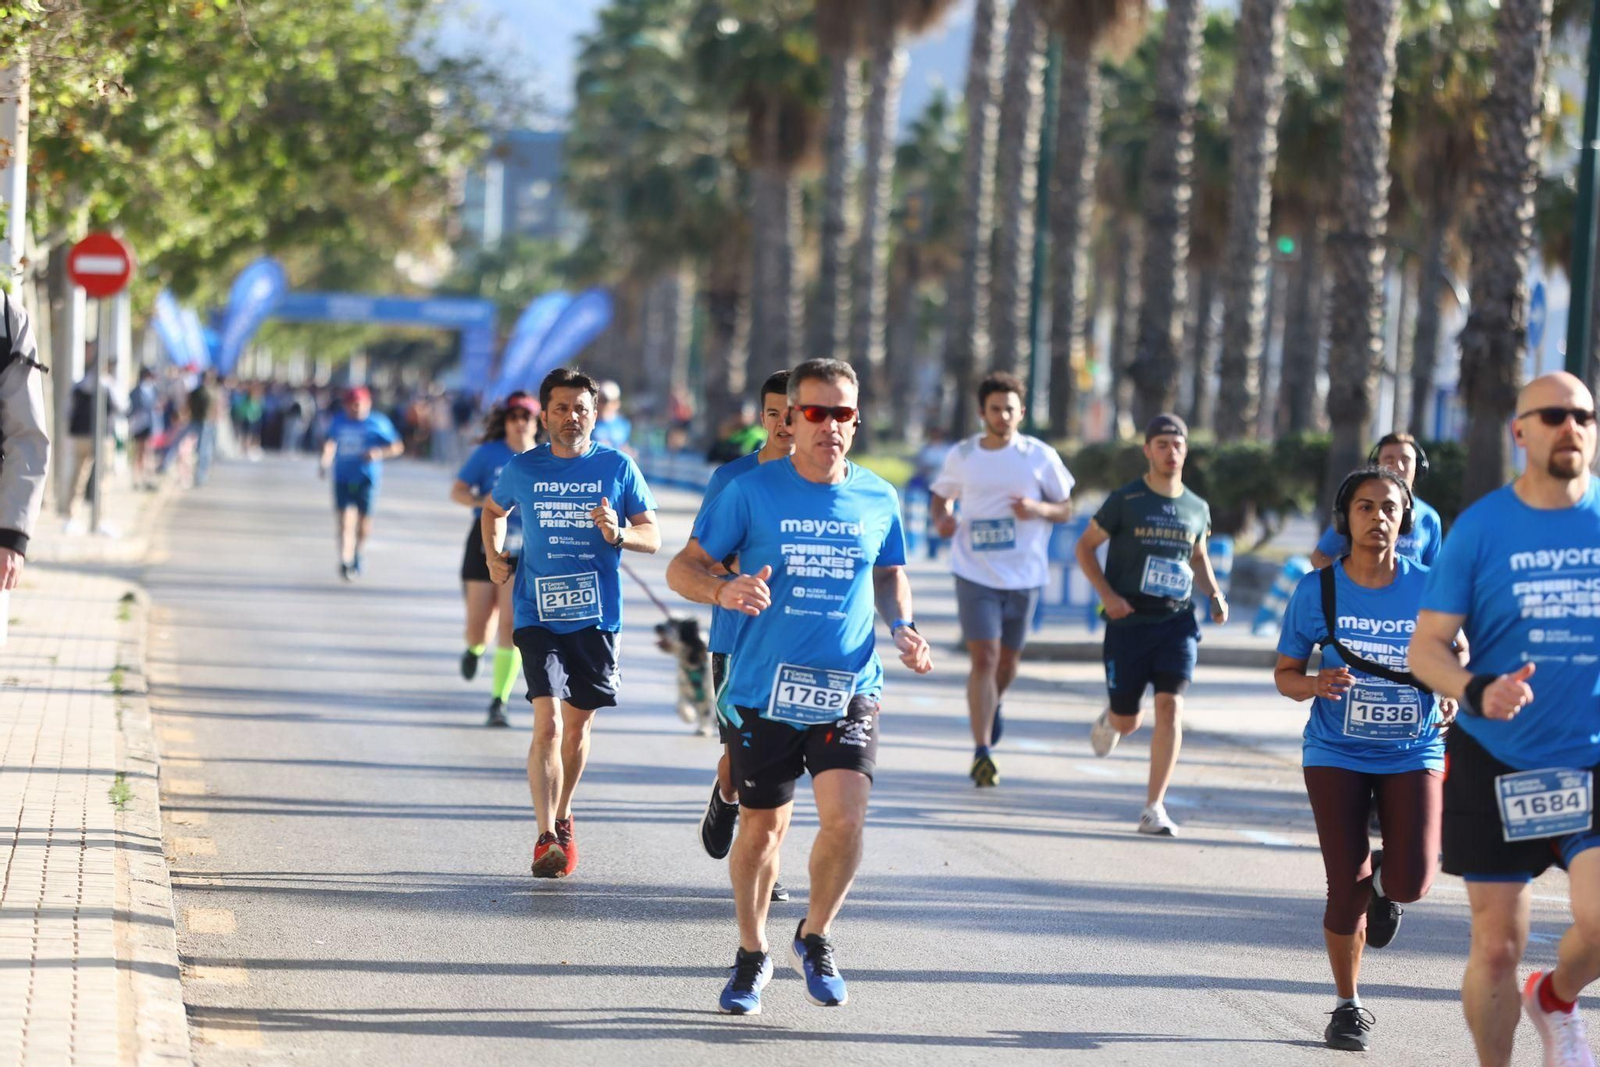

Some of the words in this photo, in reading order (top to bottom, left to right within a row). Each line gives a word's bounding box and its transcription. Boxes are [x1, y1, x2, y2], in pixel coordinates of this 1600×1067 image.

[533, 480, 602, 496] mayoral
[533, 501, 598, 511] RUNNING
[540, 510, 592, 520] MAKES
[539, 519, 595, 529] FRIENDS
[780, 519, 864, 537] mayoral
[780, 543, 865, 560] RUNNING
[1509, 547, 1600, 572] mayora
[789, 554, 855, 569] MAKES
[786, 565, 855, 580] FRIENDS
[546, 590, 593, 607] 2120
[1337, 615, 1420, 636] mayora
[1338, 637, 1410, 656] RUNNIN
[784, 685, 842, 708] 1762
[1357, 704, 1414, 722] 1636
[1513, 792, 1580, 816] 1684
